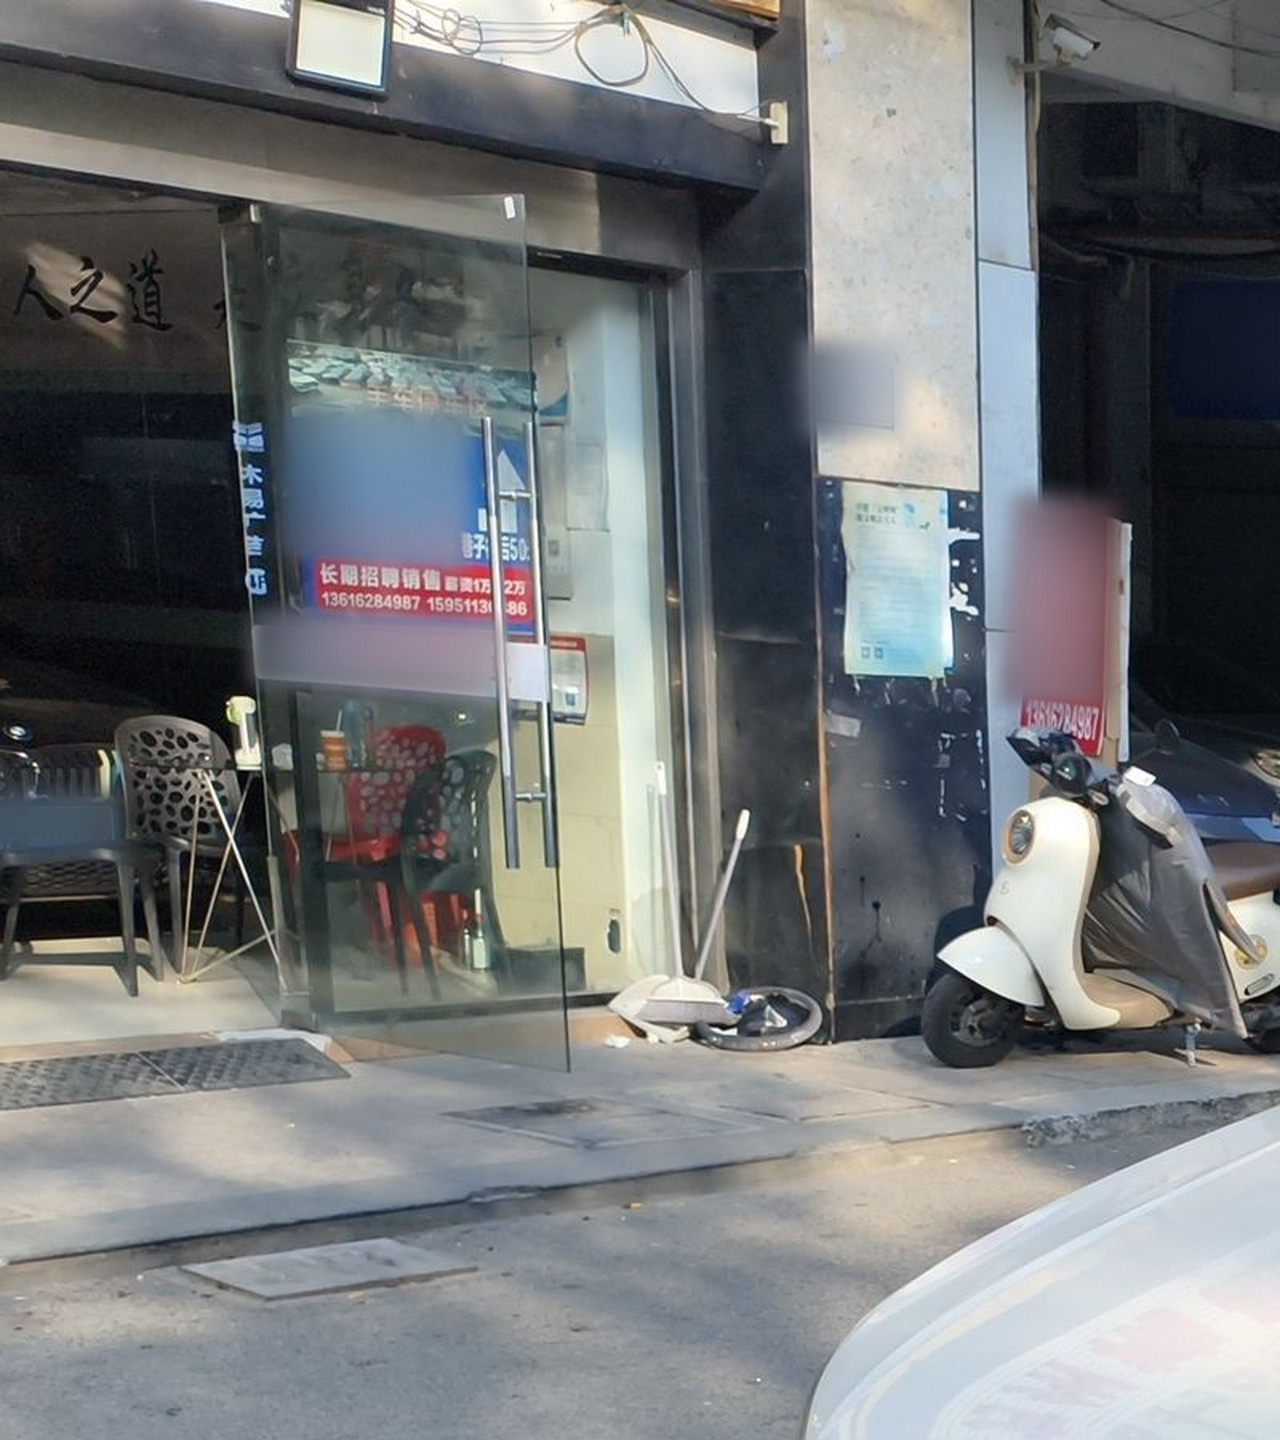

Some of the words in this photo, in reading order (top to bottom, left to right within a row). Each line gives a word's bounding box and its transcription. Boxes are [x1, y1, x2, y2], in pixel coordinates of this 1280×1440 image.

[13, 249, 174, 332] 人之道
[321, 592, 421, 611] 13616284987
